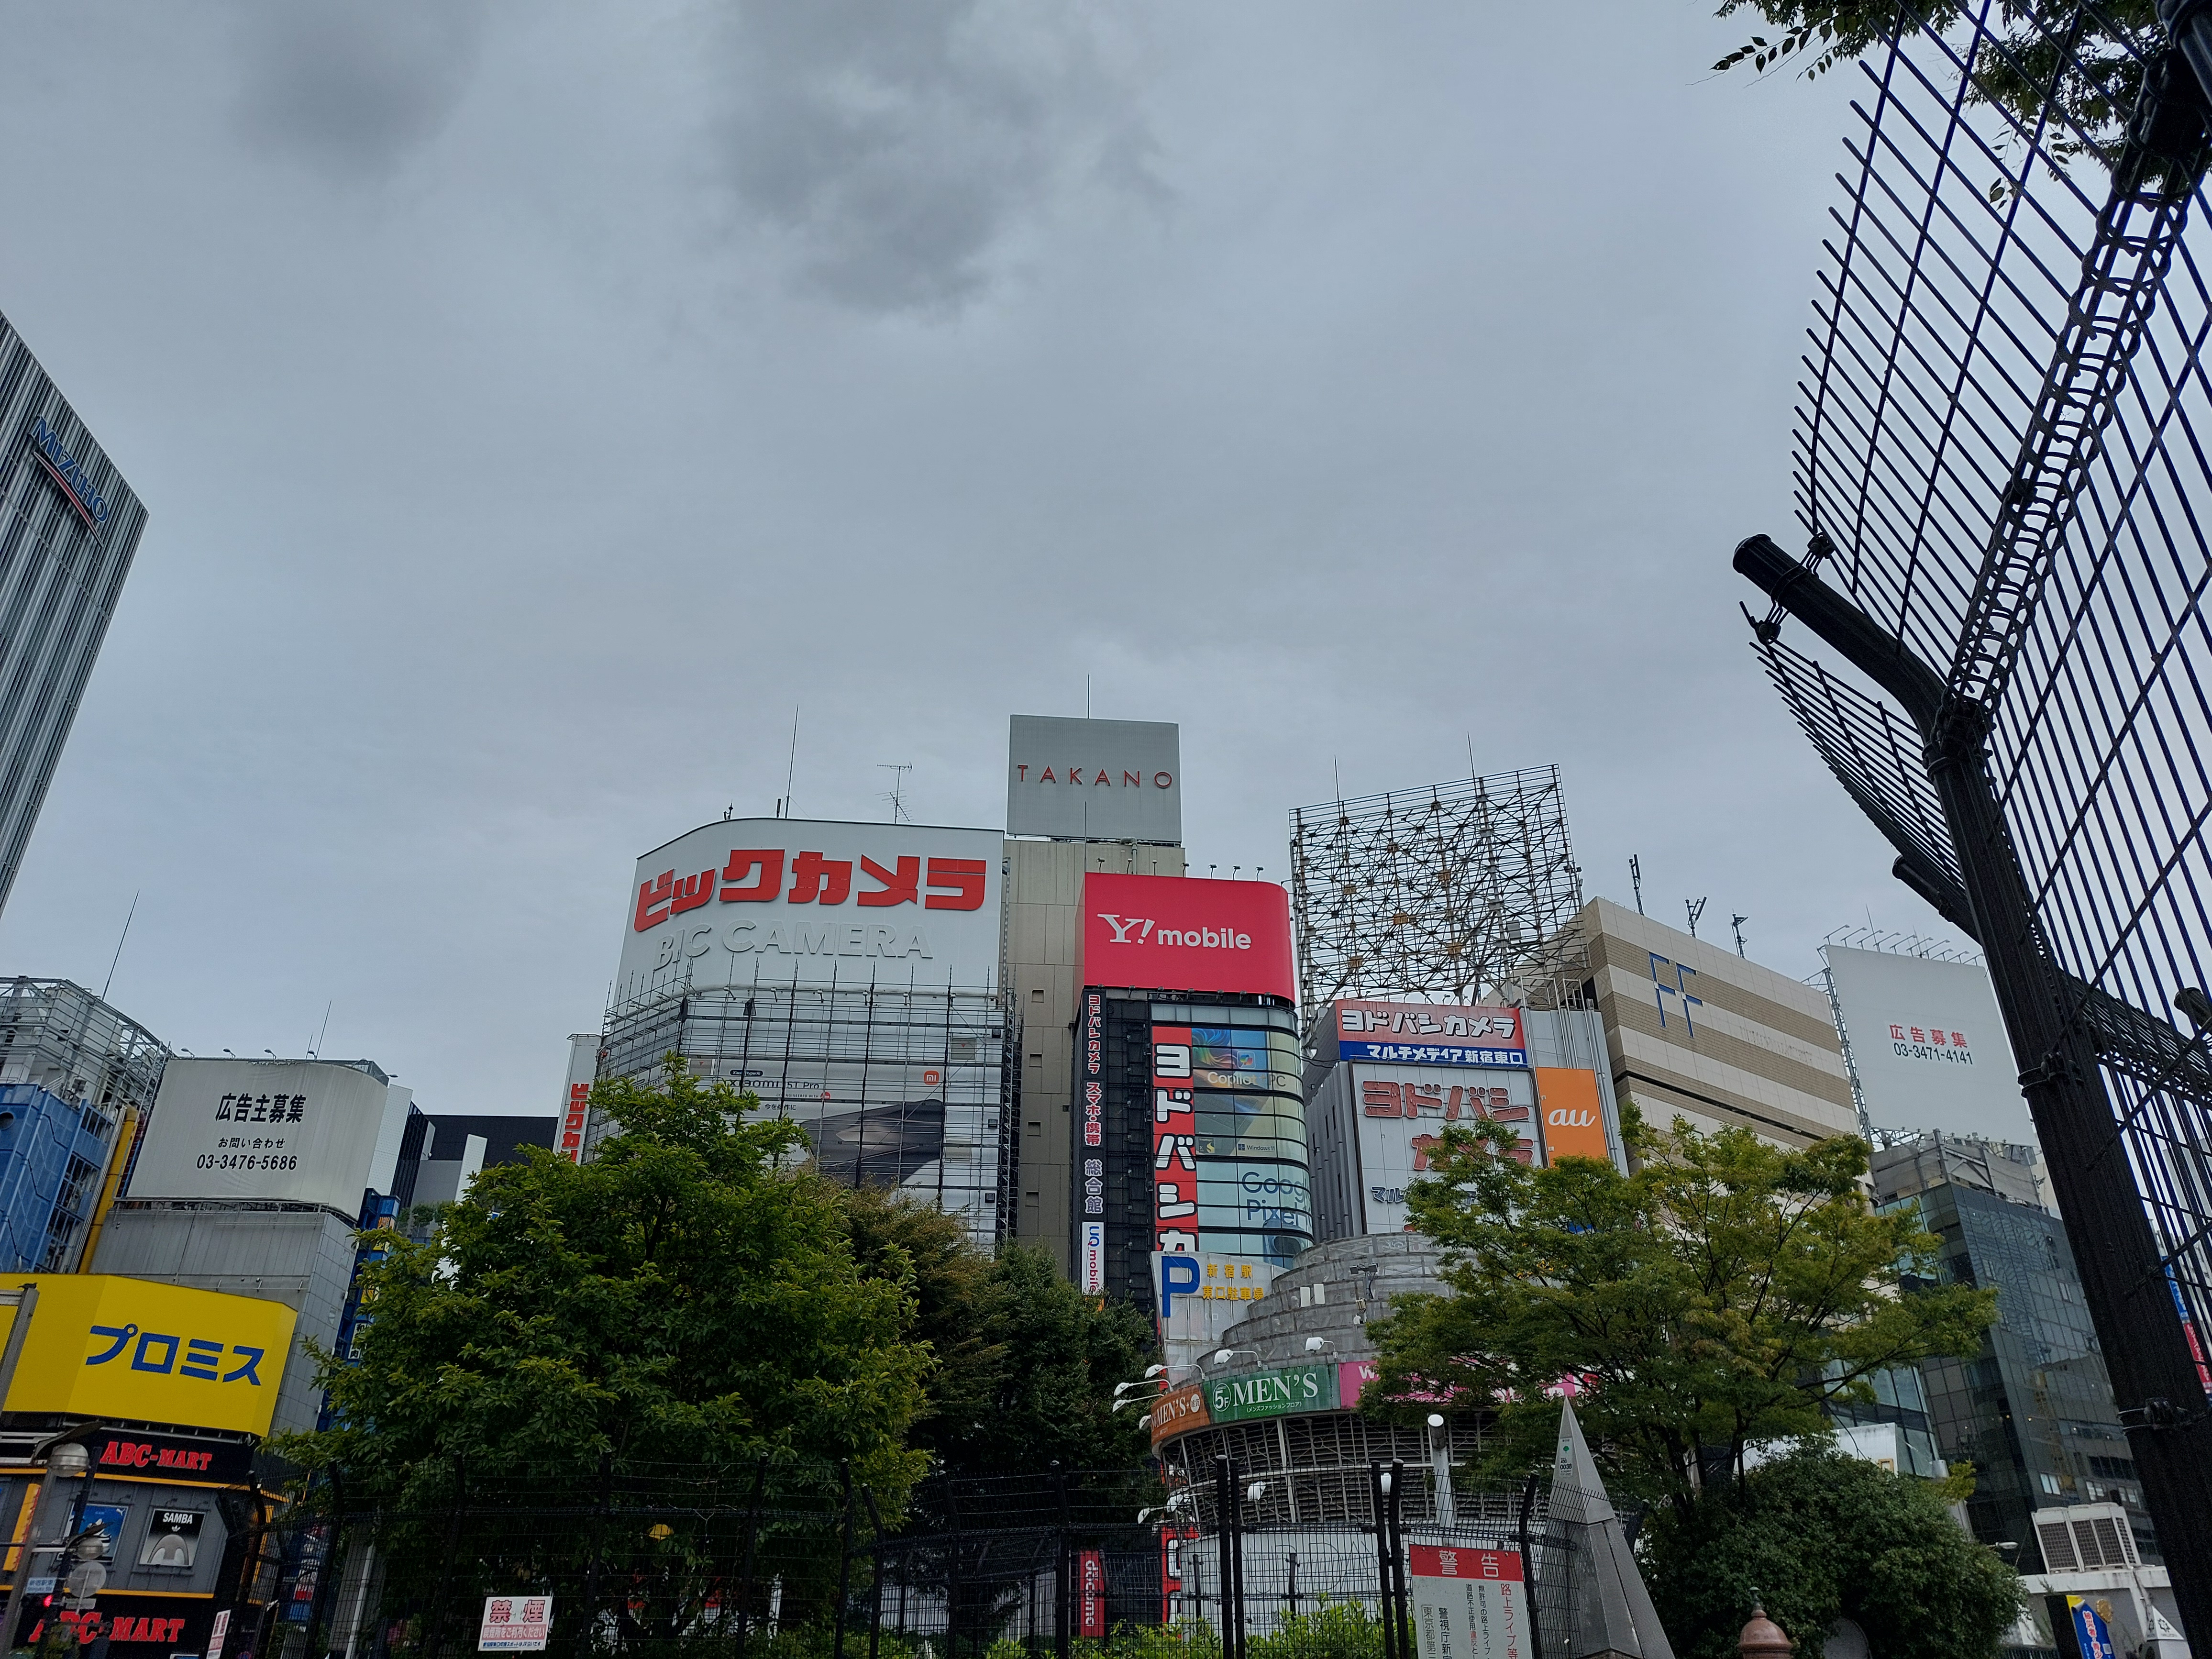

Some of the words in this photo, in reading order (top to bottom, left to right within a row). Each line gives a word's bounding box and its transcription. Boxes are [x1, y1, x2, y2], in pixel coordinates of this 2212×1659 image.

[29, 414, 109, 523] MIZUHO
[1018, 764, 1172, 789] TAKANO
[634, 849, 987, 932] ビックカメラ
[654, 924, 712, 972] BIC
[722, 920, 933, 959] CAMERA
[1158, 927, 1252, 950] mobile
[1088, 995, 1101, 1074] ヨドバシカメラ
[1341, 1009, 1515, 1039] ヨドバシカメラ
[1889, 1024, 1968, 1049] 広告募集
[1893, 1042, 1973, 1065] 03-3471-4141
[1269, 1074, 1286, 1087] PC
[215, 1093, 307, 1124] 広告主募集
[1085, 1083, 1101, 1146] スマホ・携帯
[1362, 1080, 1530, 1123] ヨドバシ
[1548, 1108, 1596, 1127] au
[218, 1137, 286, 1150] お問い合わせ
[196, 1154, 298, 1171] 03-3476-5686
[1084, 1159, 1103, 1214] 総合館
[1247, 1199, 1299, 1226] Pixel
[1088, 1226, 1100, 1247] UQ
[1207, 1263, 1252, 1279] 新宿駅
[1161, 1256, 1200, 1317] P
[1202, 1285, 1264, 1300] 東口駐車場
[86, 1323, 265, 1386] プロミス
[1232, 1372, 1318, 1407] MEN'S
[100, 1441, 212, 1471] ABC-MART
[163, 1512, 193, 1524] SAMBA
[1438, 1550, 1499, 1578] 警告
[1085, 1560, 1098, 1626] docomo
[489, 1600, 546, 1623] 禁煙
[1466, 1584, 1478, 1659] 道路不正使用違反と
